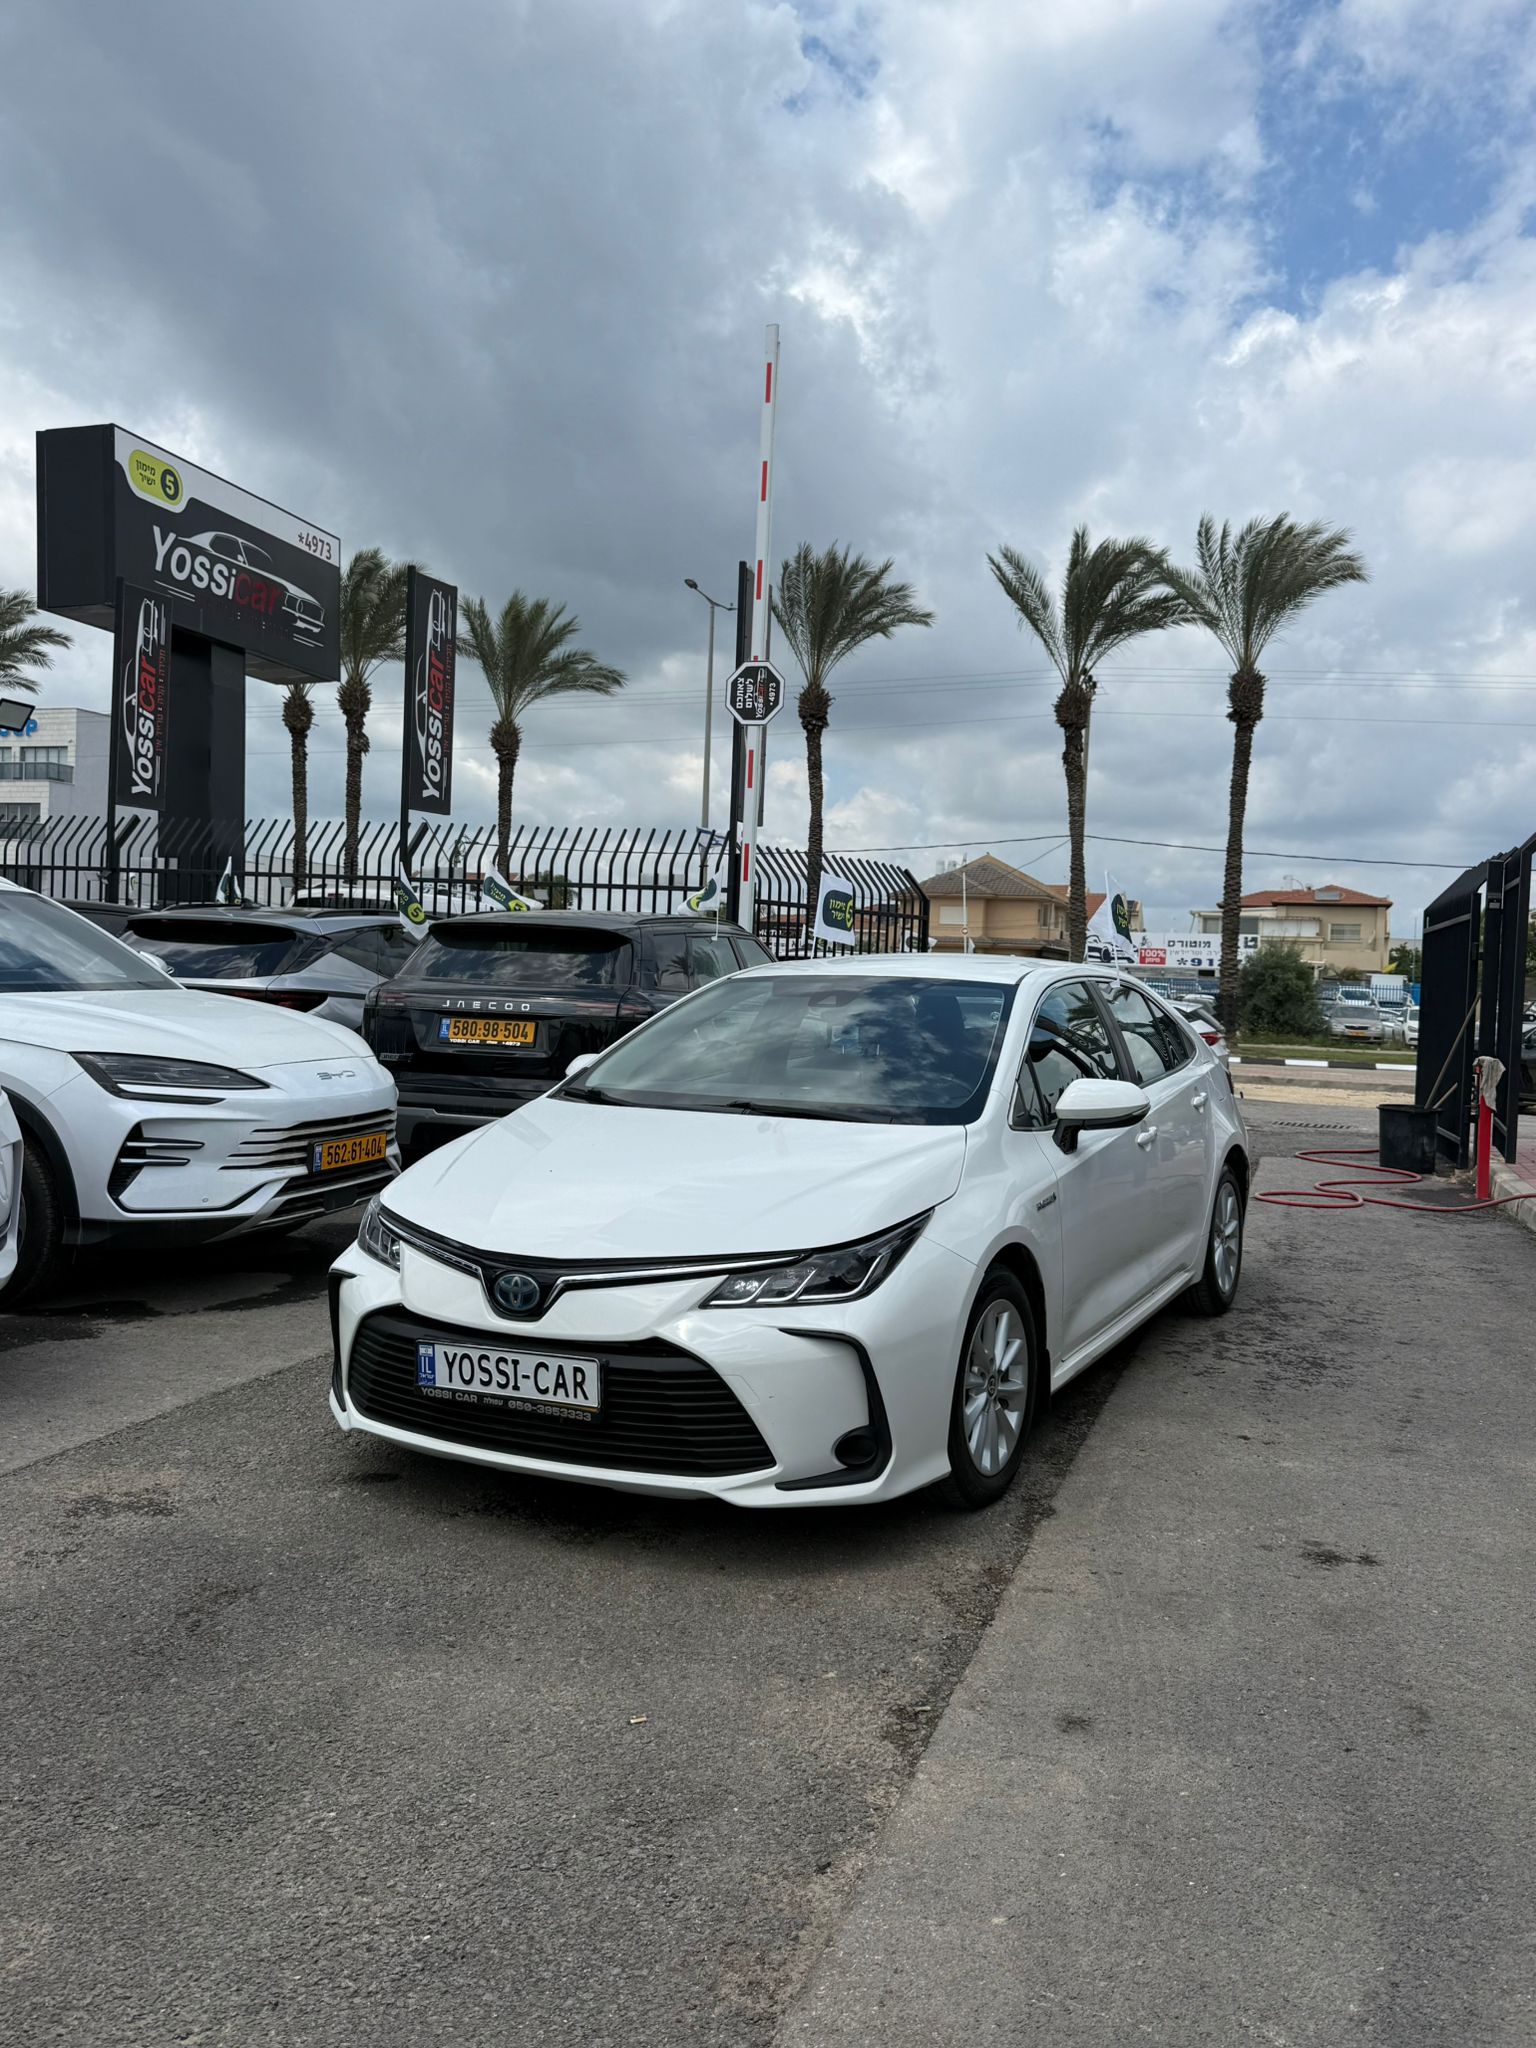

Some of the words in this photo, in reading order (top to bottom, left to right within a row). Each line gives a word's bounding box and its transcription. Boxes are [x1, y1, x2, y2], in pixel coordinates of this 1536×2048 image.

[136, 459, 156, 477] מימון
[139, 472, 156, 486] ישיר
[165, 474, 175, 496] 5
[736, 677, 745, 709] צאתכם
[745, 678, 754, 709] לשלום
[411, 905, 422, 917] 5
[1140, 949, 1166, 958] 100%
[1167, 940, 1211, 949] מוטורס
[441, 1000, 530, 1011] JAECOO
[316, 1070, 356, 1080] BYD
[421, 1356, 432, 1374] IL
[443, 1350, 589, 1400] YOSSI-CAR
[421, 1387, 453, 1400] YOSSI
[455, 1392, 478, 1404] CAR
[508, 1400, 592, 1422] 050-3953333
